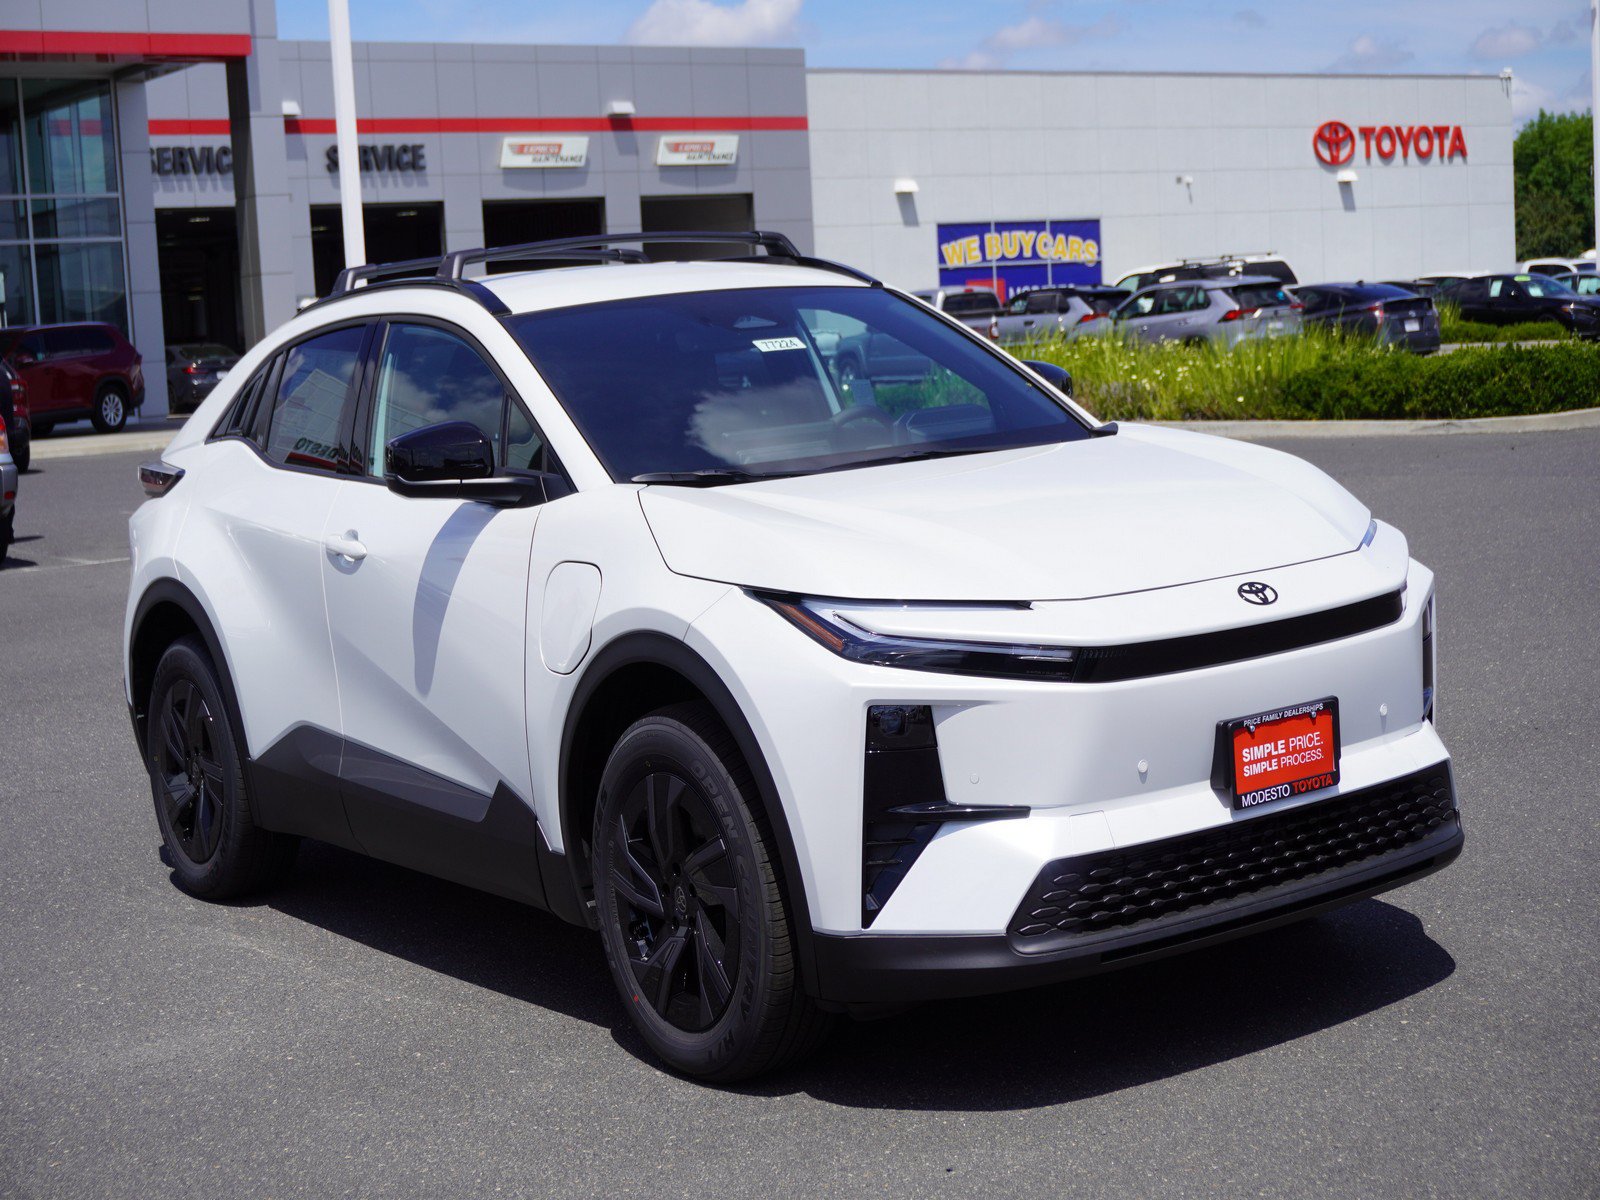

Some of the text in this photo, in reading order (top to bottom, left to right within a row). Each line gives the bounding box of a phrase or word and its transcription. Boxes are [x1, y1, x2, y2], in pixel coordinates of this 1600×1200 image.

[1358, 125, 1468, 159] TOYOTA
[149, 145, 233, 175] ERVIC
[325, 144, 426, 173] SRVICE
[941, 230, 1099, 269] WE BUY CARS
[761, 339, 798, 349] 77224
[1243, 703, 1324, 727] PRICE FAMILY DEALERSHIPS
[1242, 732, 1324, 763] SIMPLE PRICE.
[1243, 748, 1324, 777] SIMPLE PROCESS.
[690, 760, 740, 839] OPEN
[1241, 774, 1333, 808] MODESTO TOYOTA
